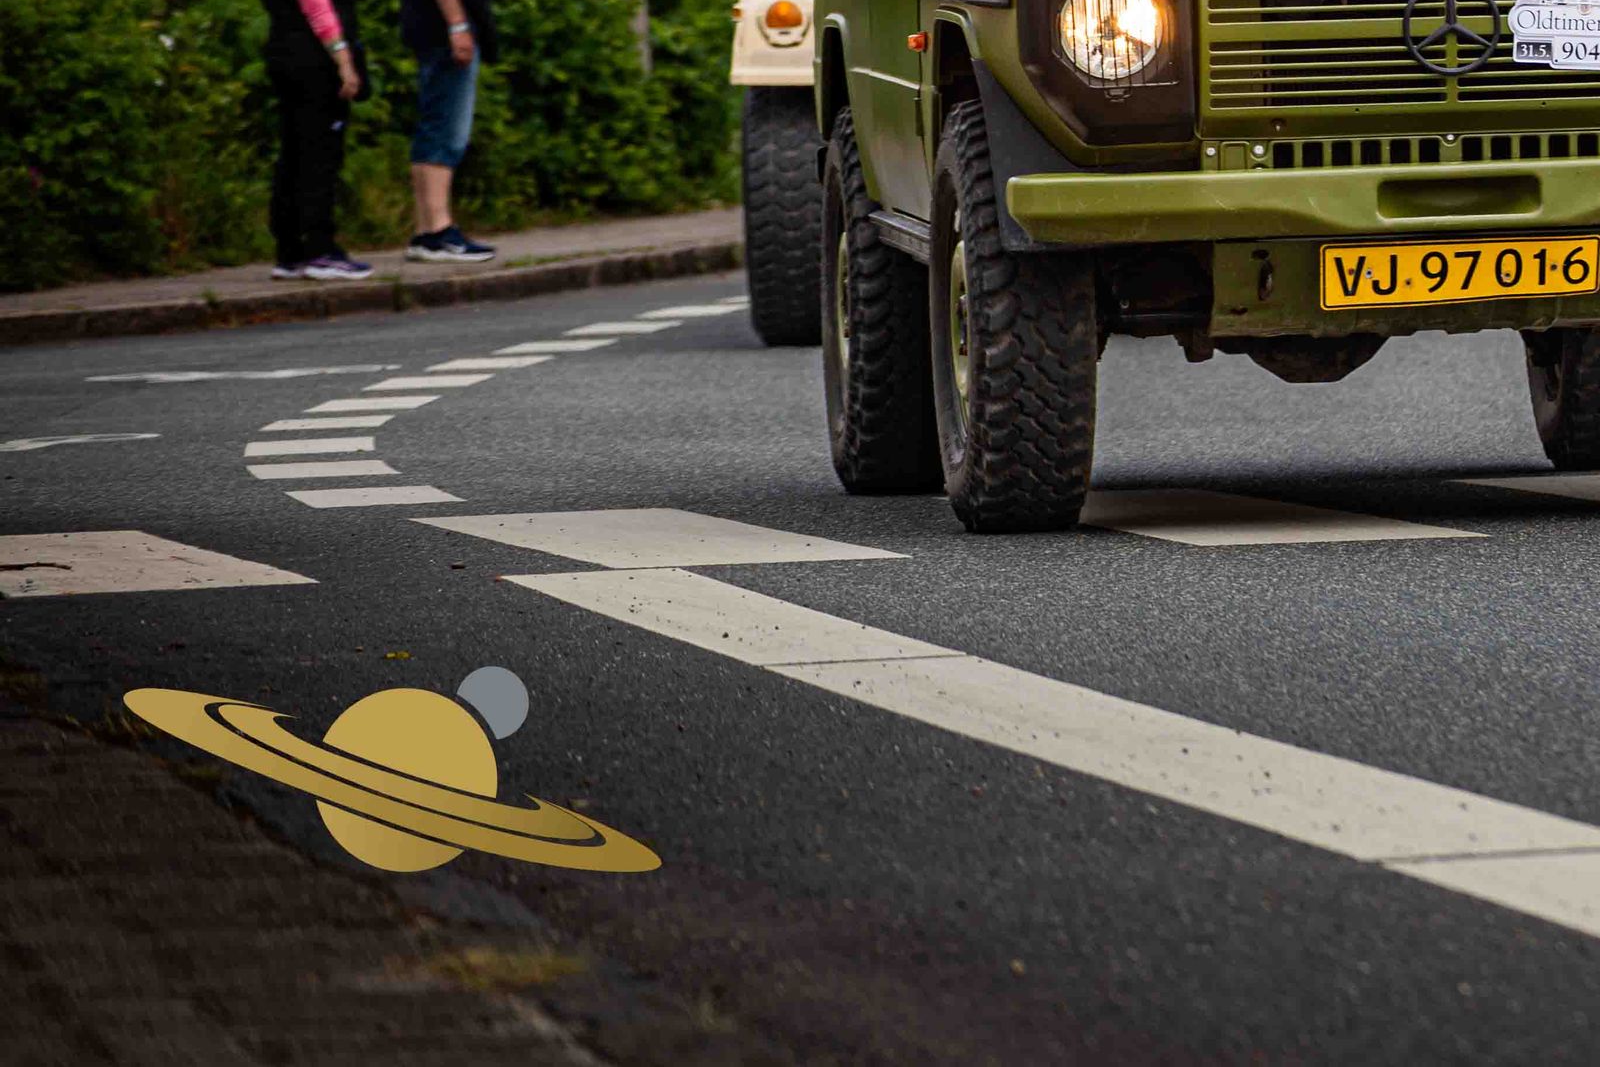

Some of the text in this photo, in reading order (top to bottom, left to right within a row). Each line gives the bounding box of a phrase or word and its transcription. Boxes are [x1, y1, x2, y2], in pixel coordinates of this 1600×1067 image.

[1521, 44, 1550, 58] 31.5.
[1562, 41, 1600, 61] 904
[1334, 254, 1398, 296] VJ
